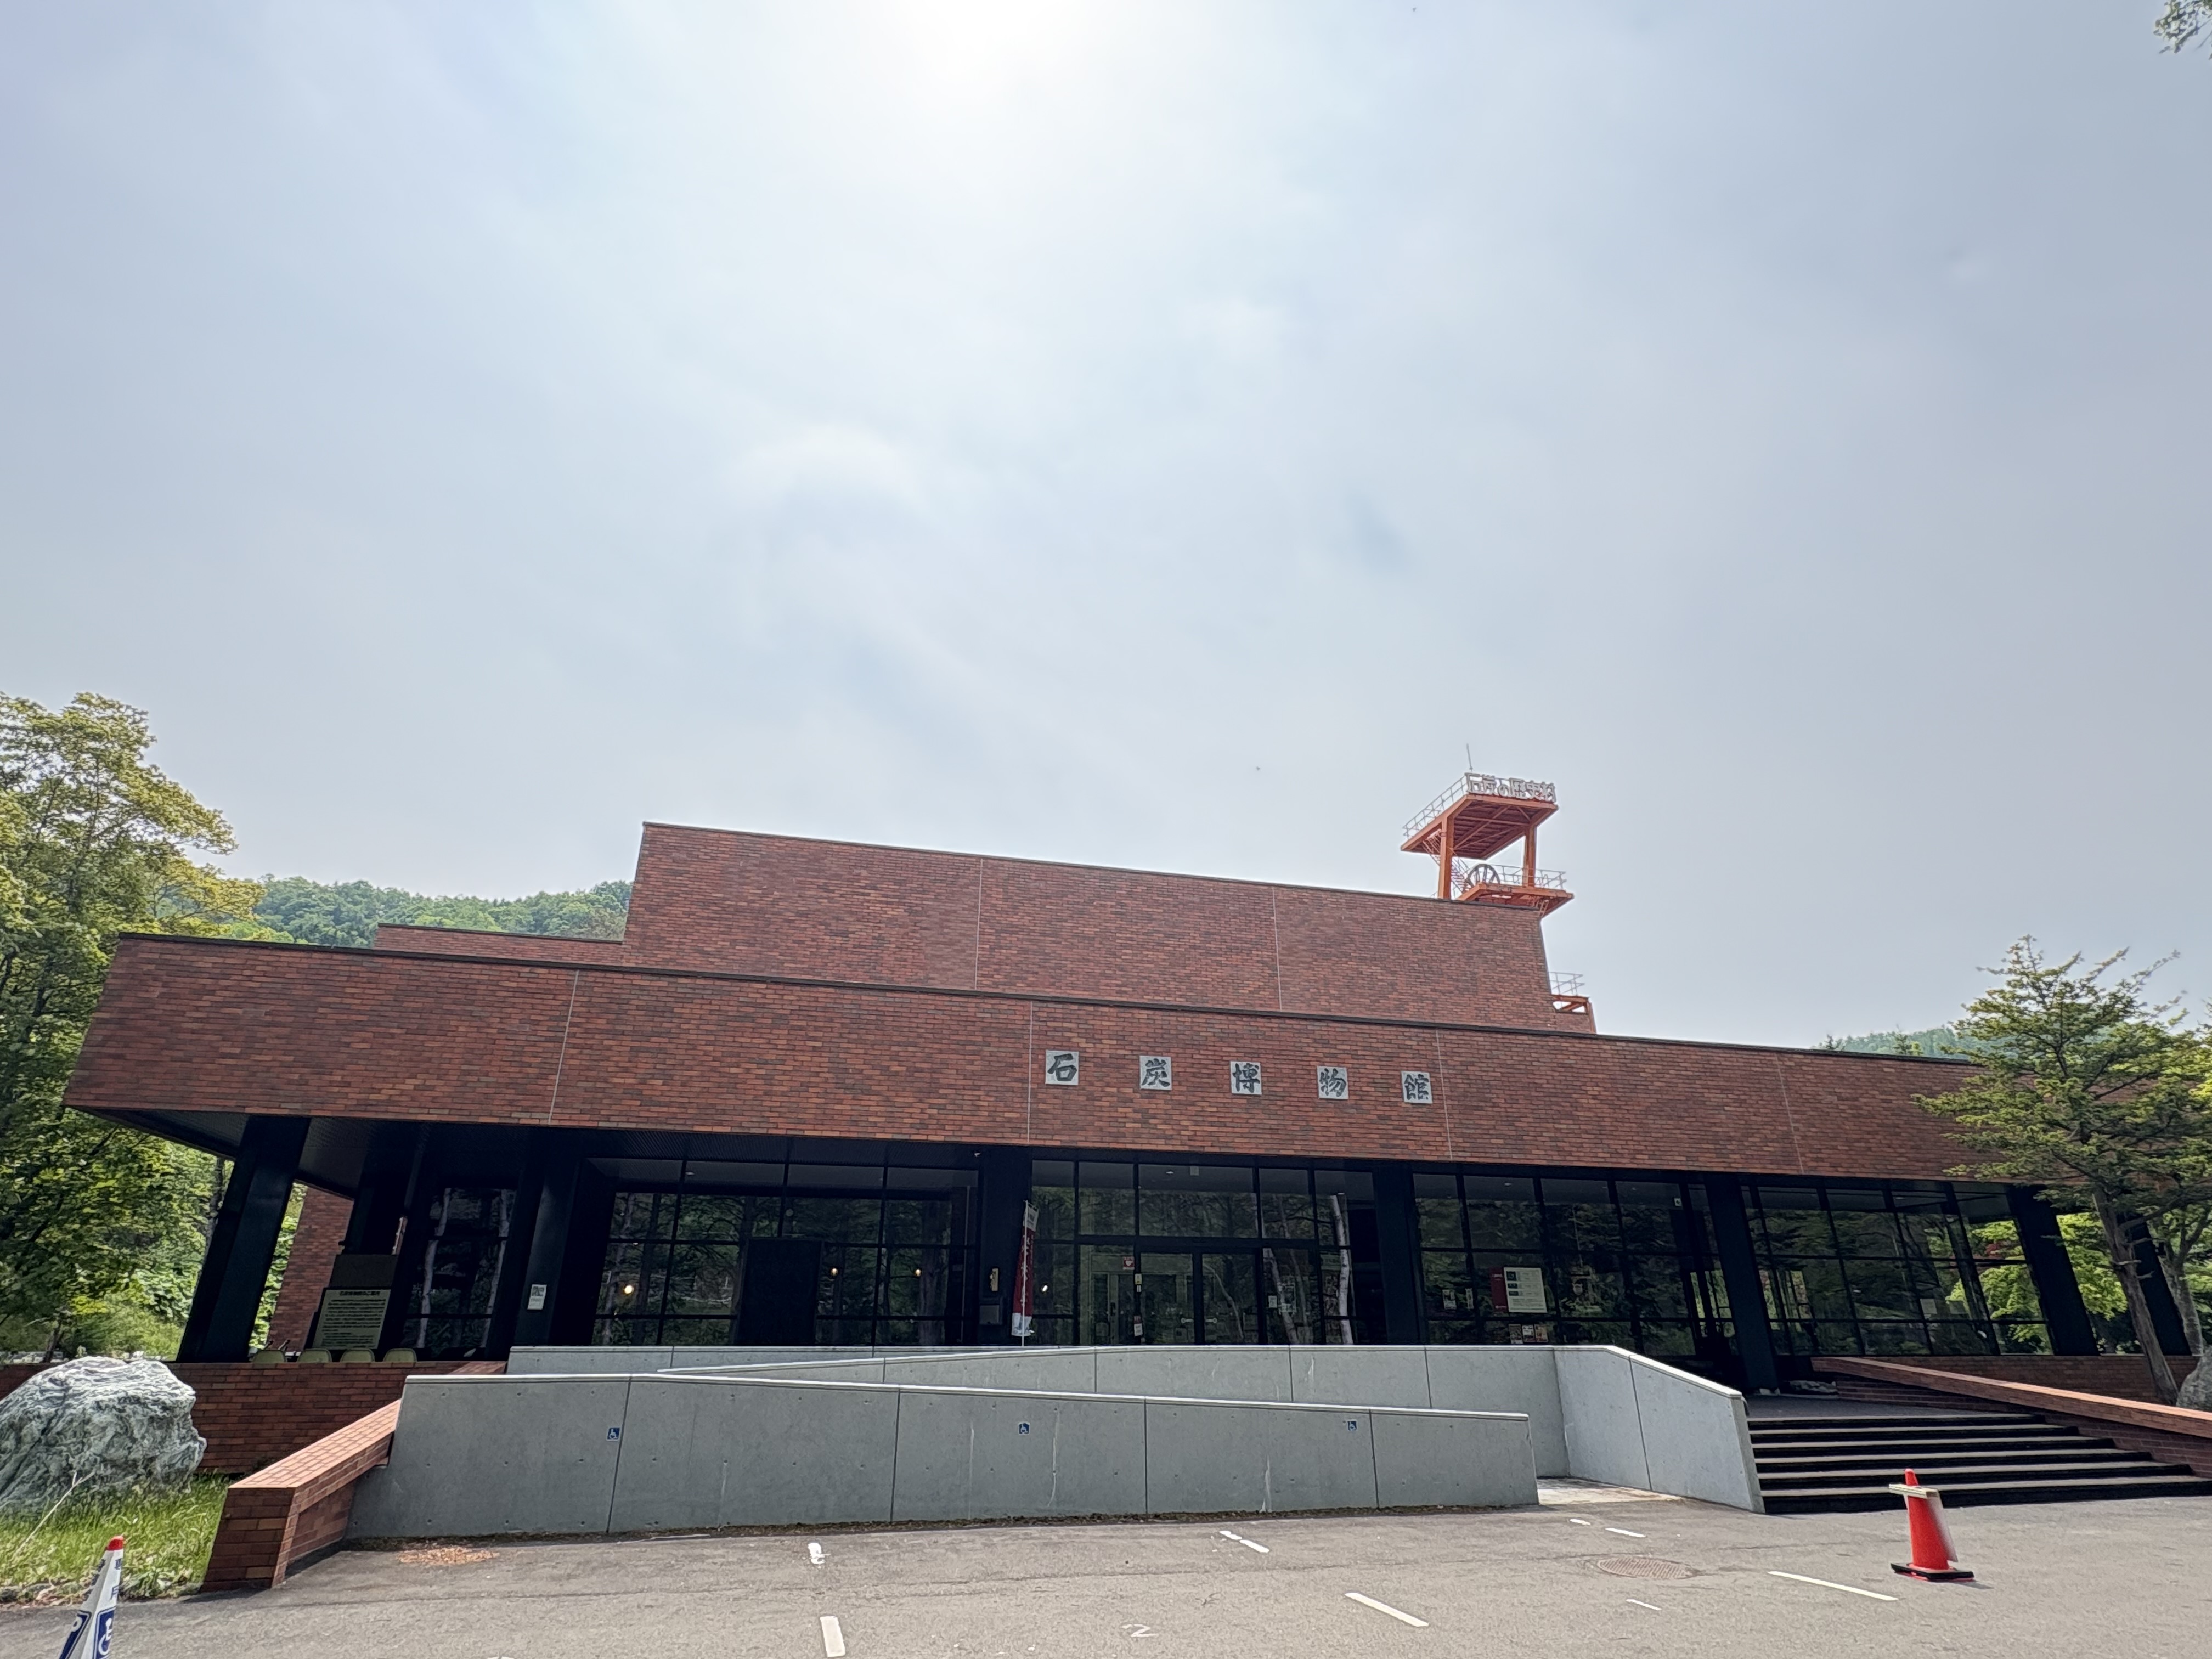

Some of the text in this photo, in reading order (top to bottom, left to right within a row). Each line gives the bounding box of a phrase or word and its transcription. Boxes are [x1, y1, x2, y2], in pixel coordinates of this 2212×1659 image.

[1047, 1053, 1430, 1101] 石炭博物館
